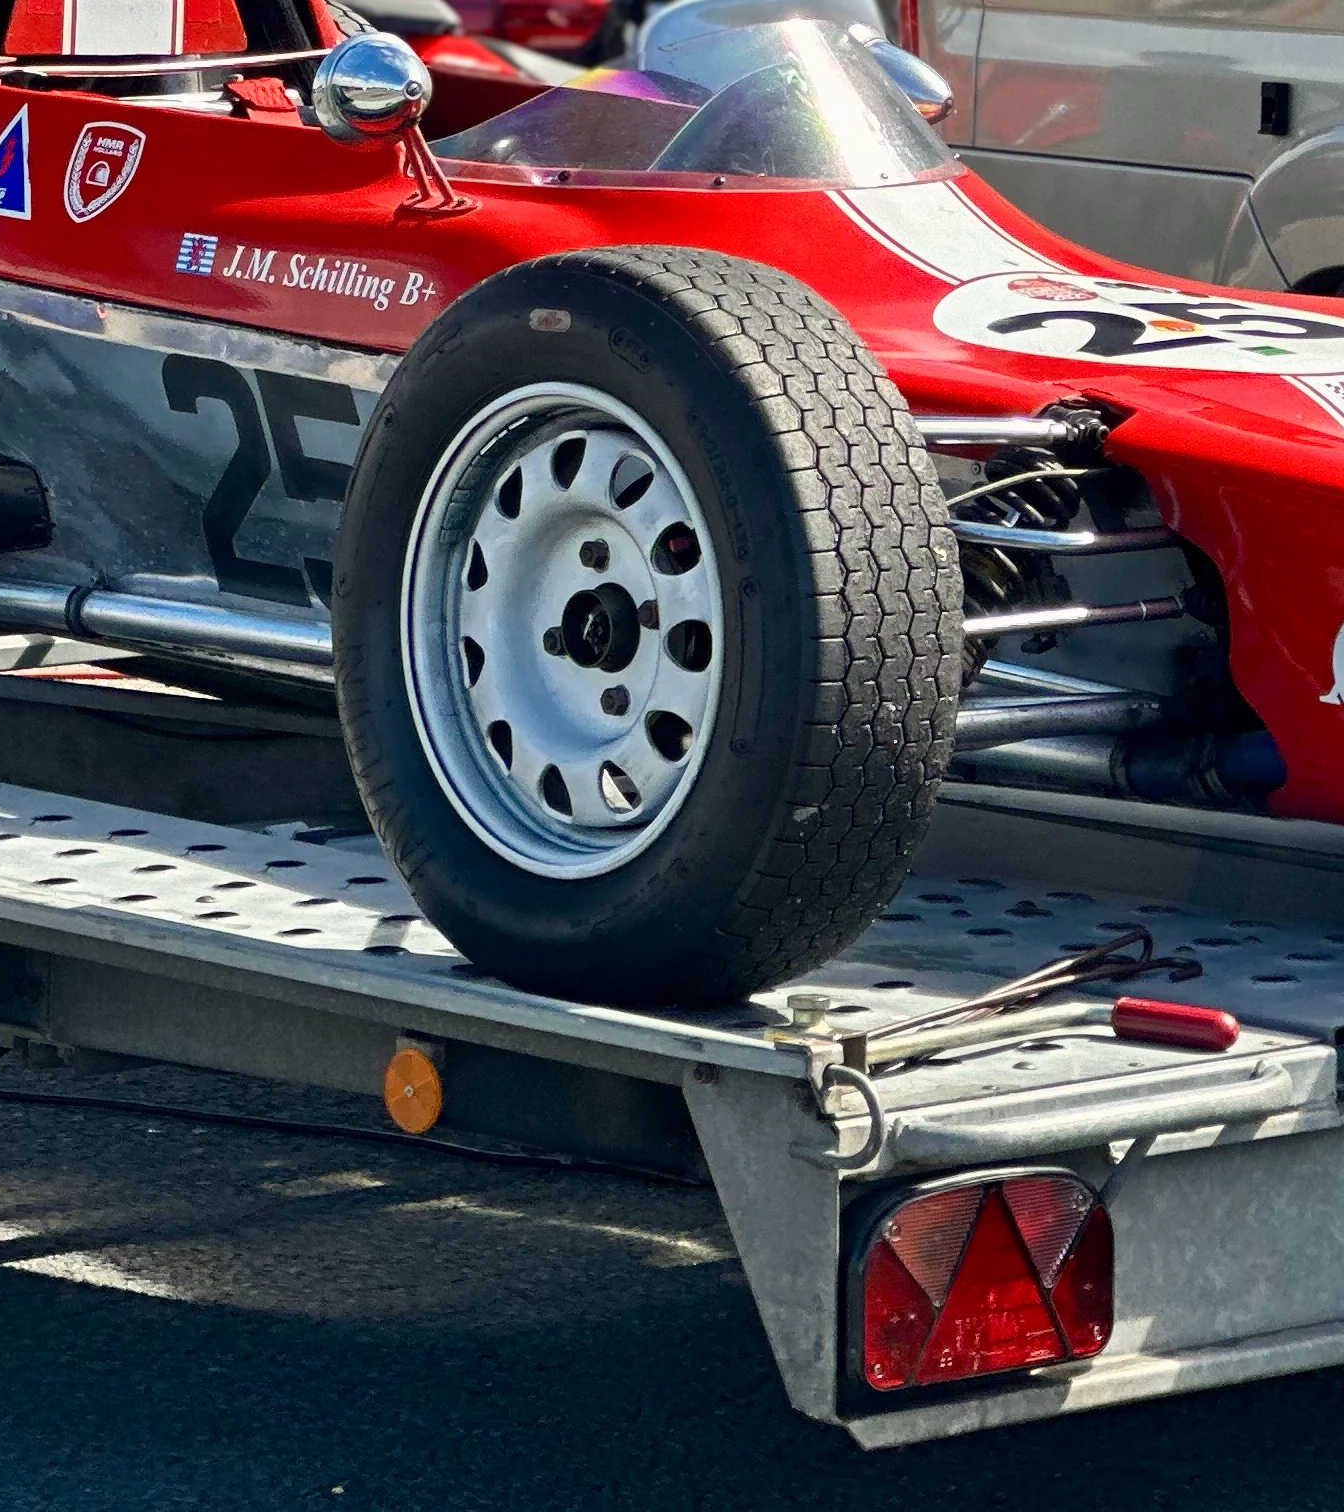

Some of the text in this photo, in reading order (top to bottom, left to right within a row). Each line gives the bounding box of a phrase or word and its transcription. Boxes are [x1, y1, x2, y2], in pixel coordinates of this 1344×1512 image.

[223, 245, 436, 311] J.M. Schilling B+
[161, 353, 360, 610] 25
